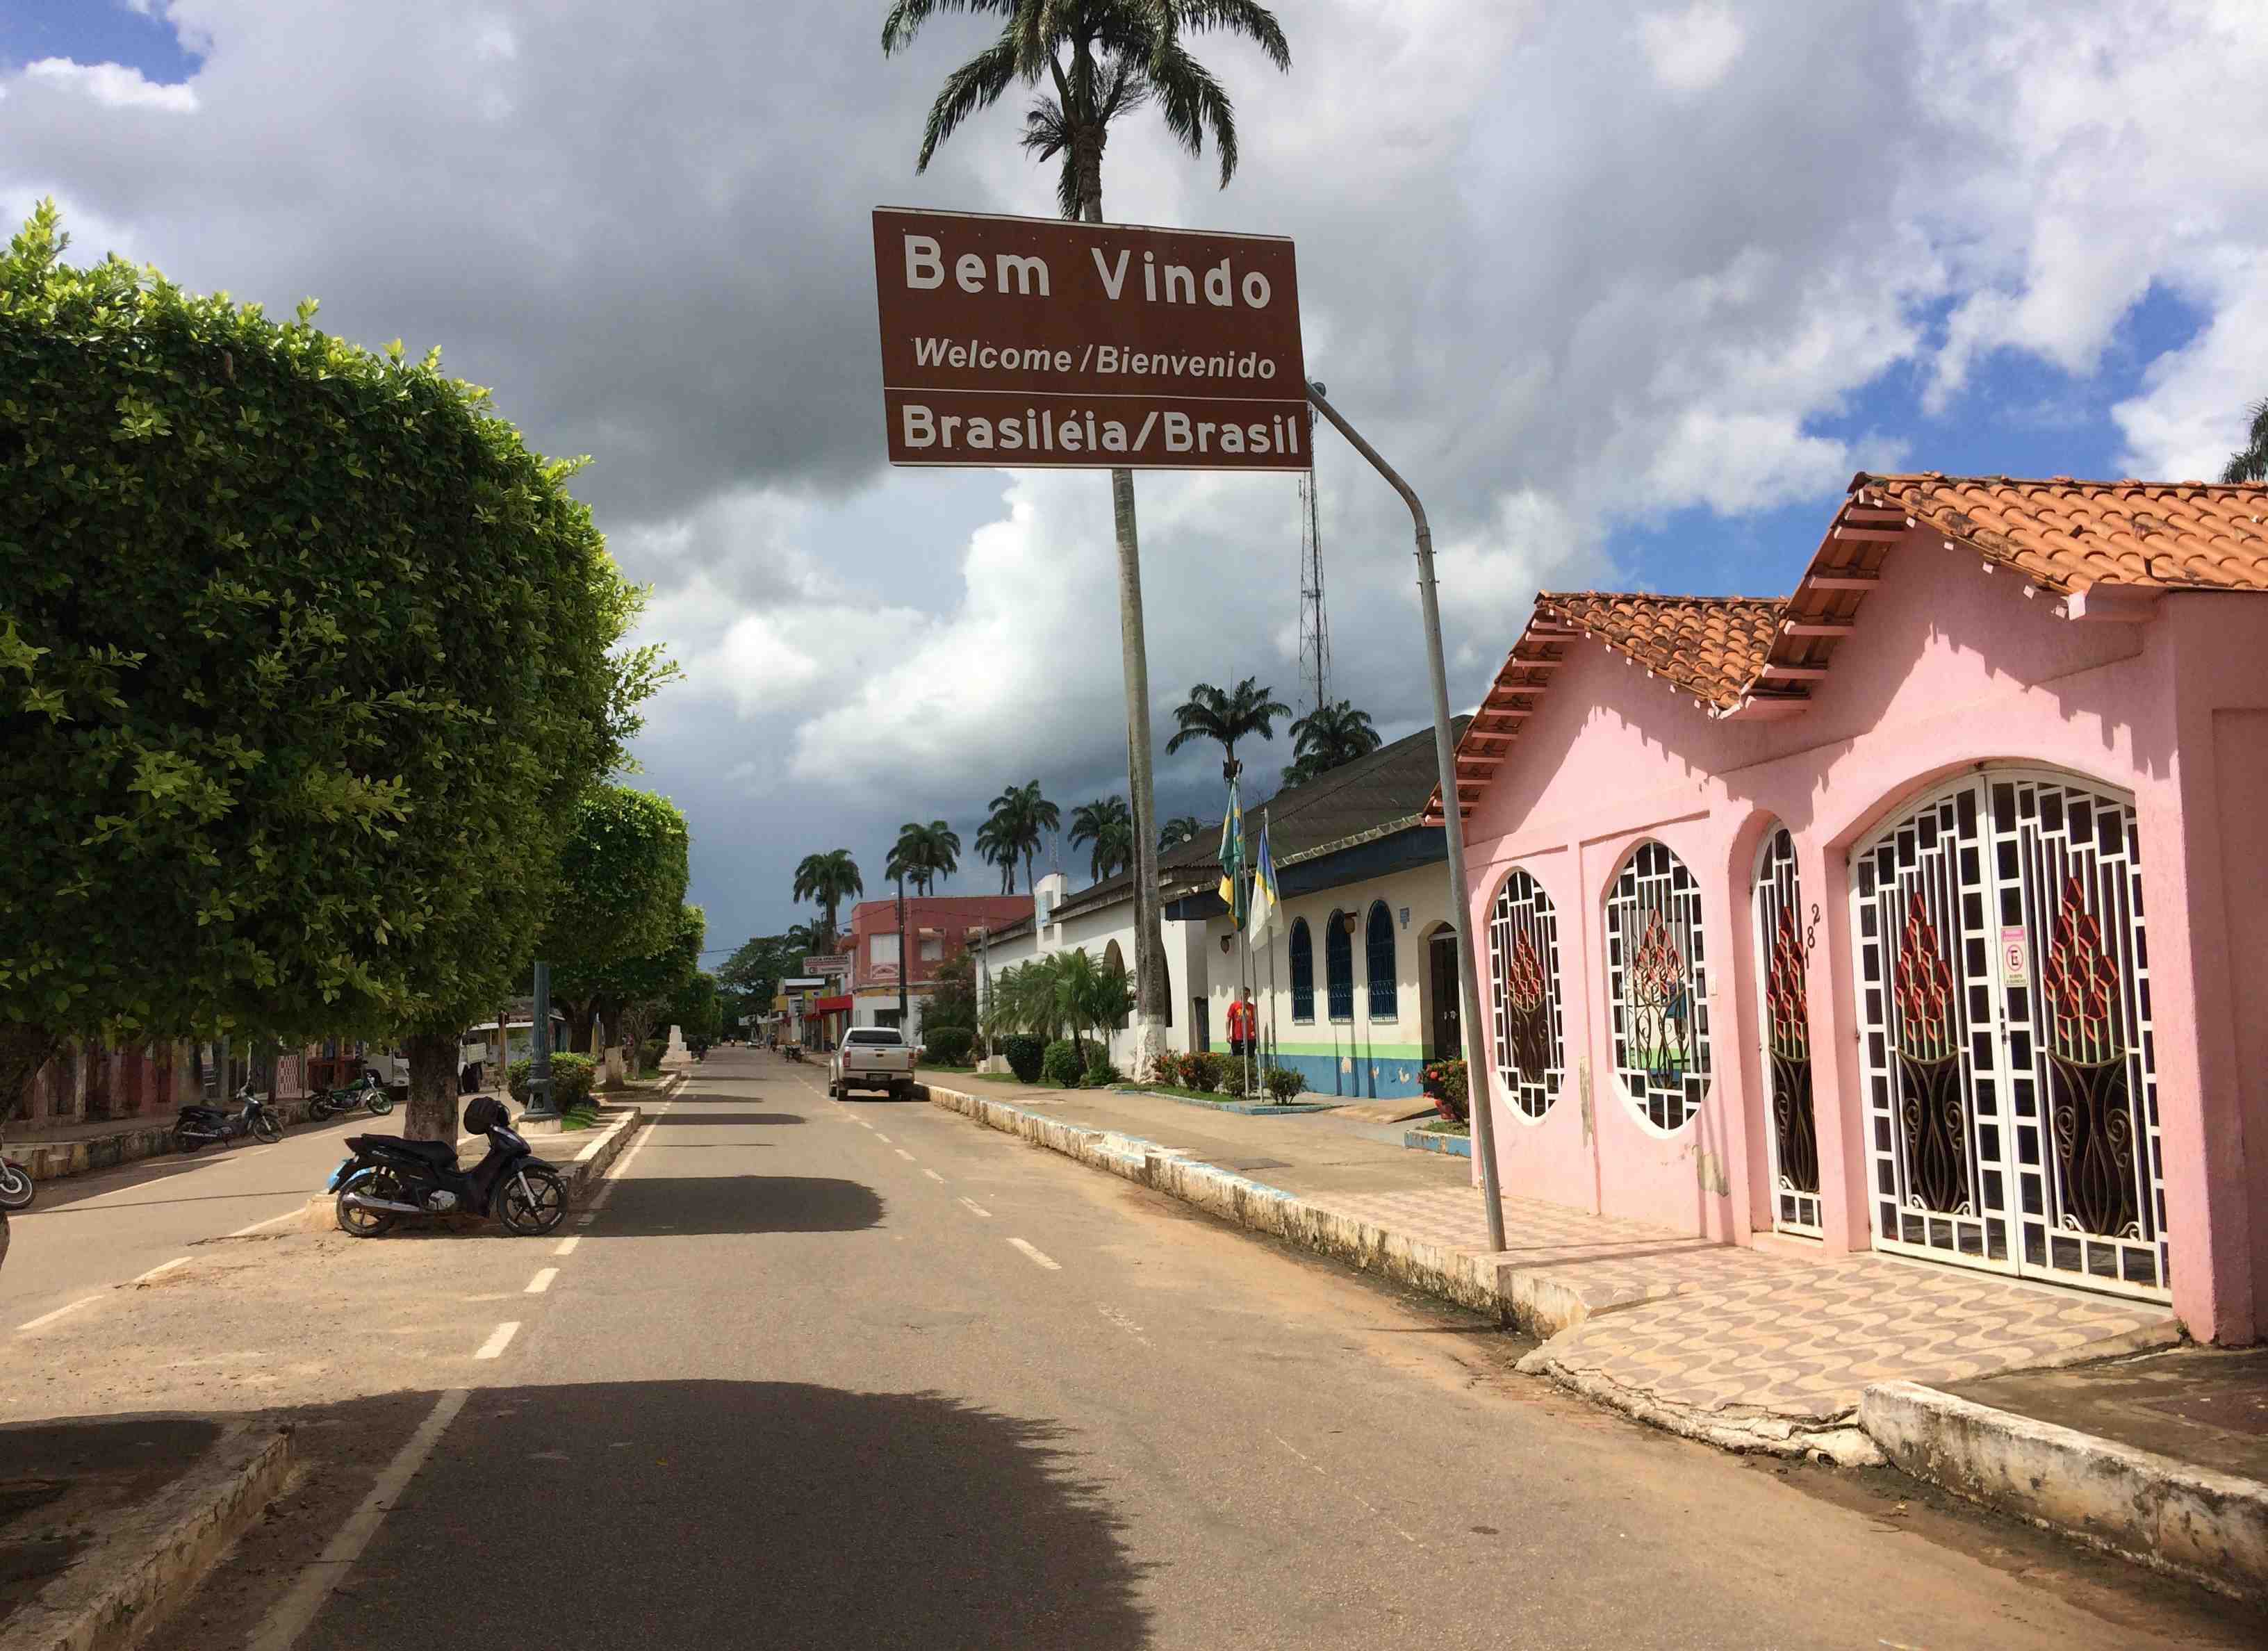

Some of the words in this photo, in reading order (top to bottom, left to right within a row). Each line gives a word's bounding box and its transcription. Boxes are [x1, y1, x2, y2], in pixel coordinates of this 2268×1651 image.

[905, 234, 1050, 297] Bem
[1091, 247, 1271, 309] Vindo
[914, 337, 1072, 372] Welcome
[903, 404, 1298, 454] Brasiléia/Brasil
[1805, 904, 1821, 969] 281
